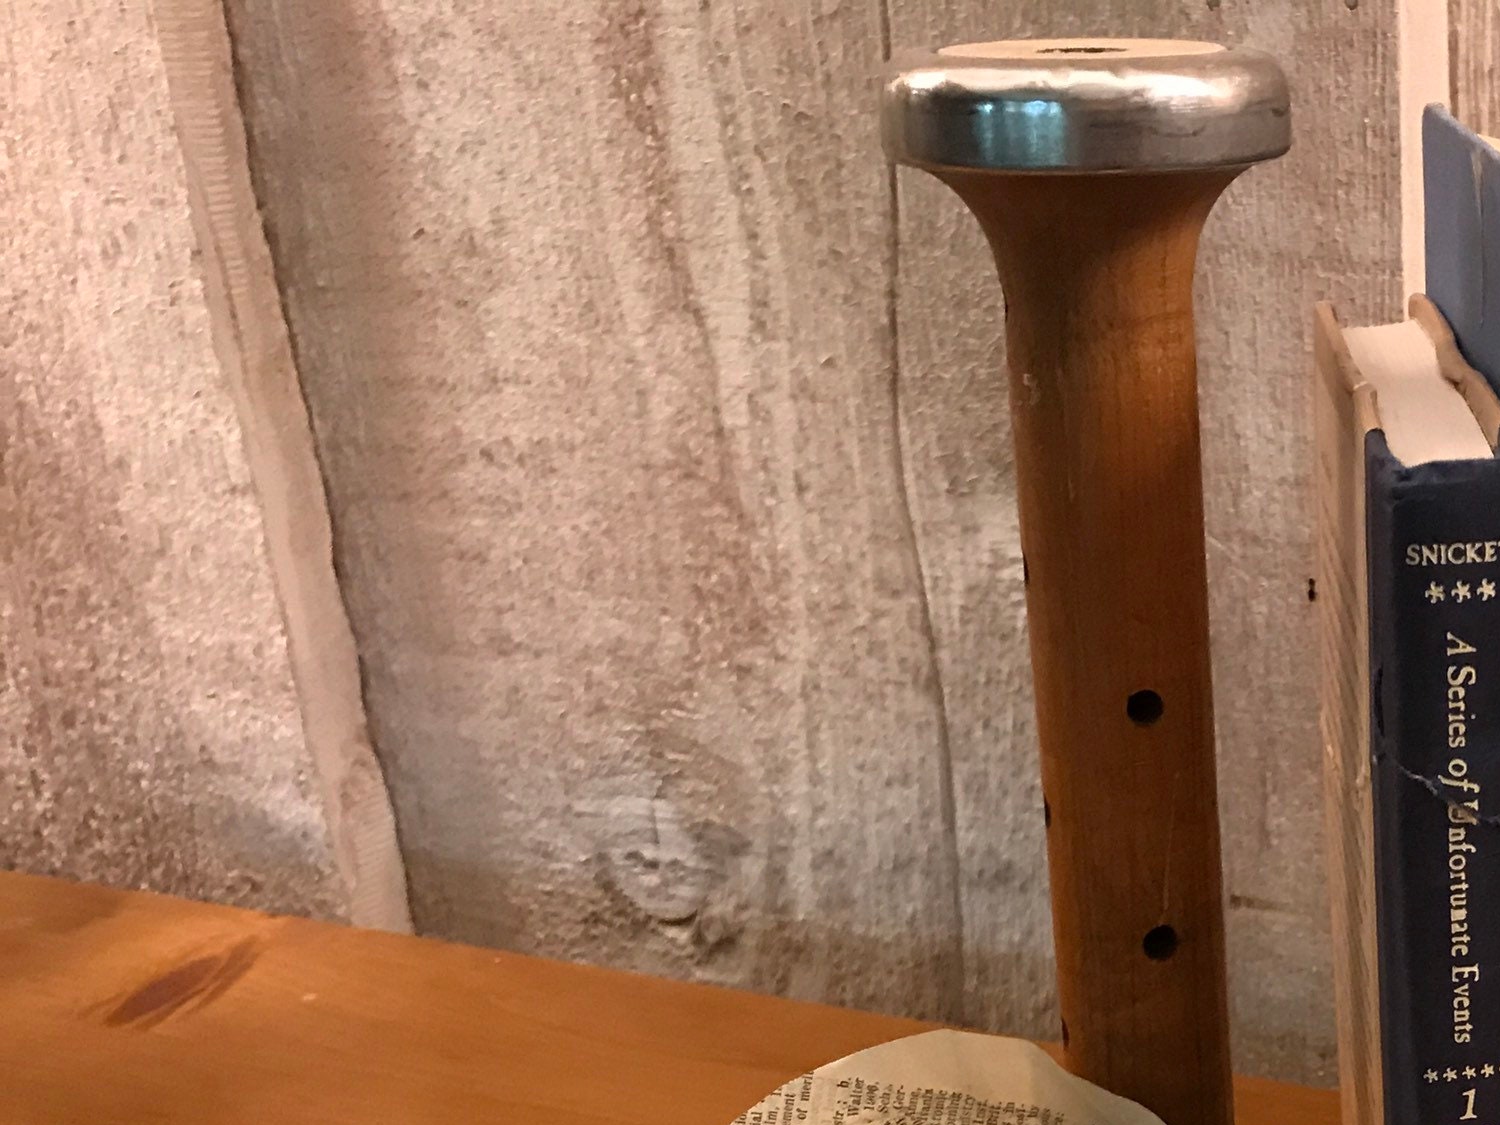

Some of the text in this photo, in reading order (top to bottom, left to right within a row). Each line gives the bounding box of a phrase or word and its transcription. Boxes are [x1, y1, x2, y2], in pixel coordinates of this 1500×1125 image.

[1438, 631, 1480, 1044] A Series of Unfortunate Events
[1459, 1089, 1478, 1121] 1
